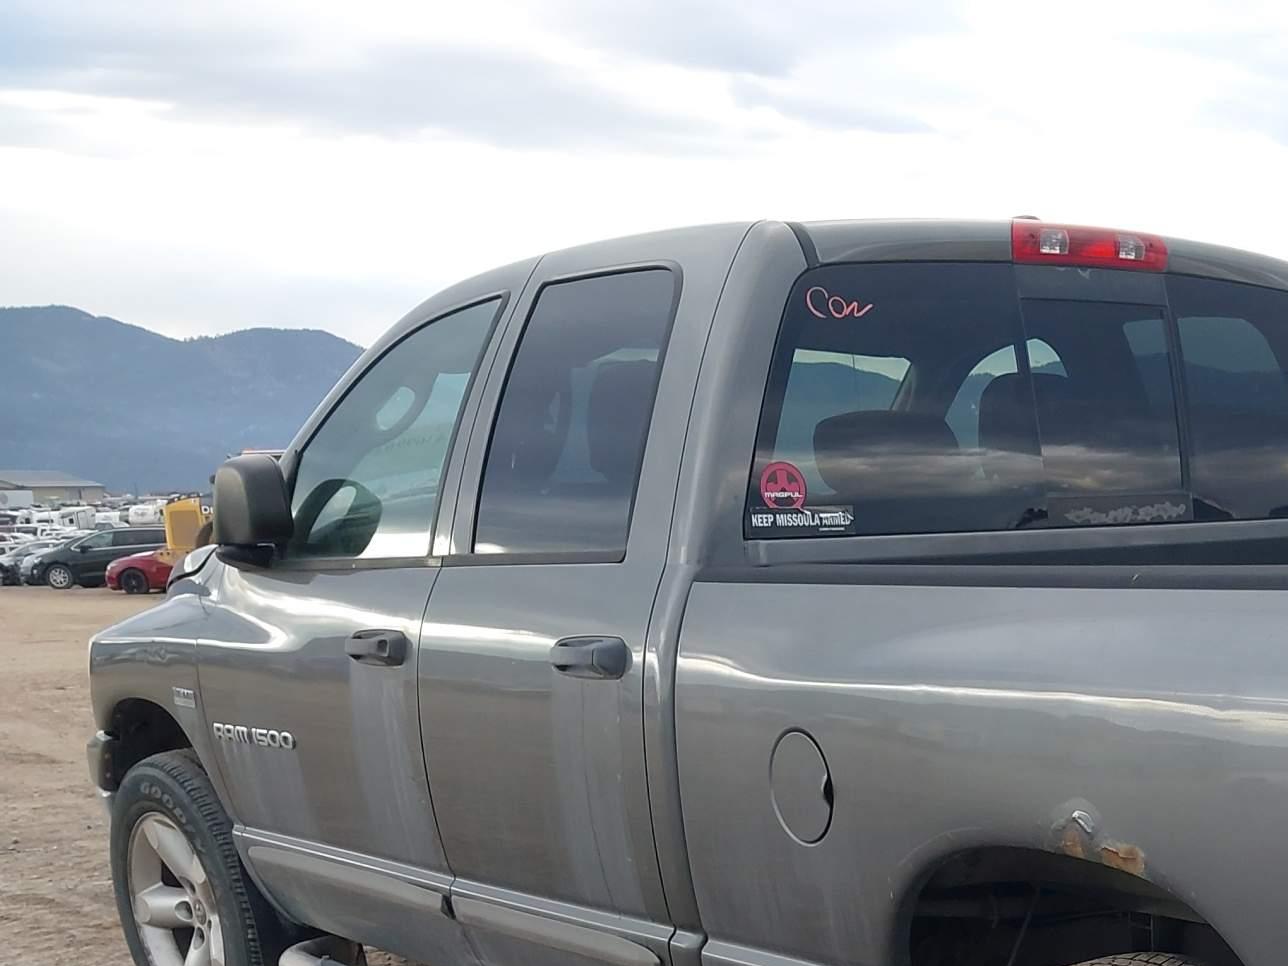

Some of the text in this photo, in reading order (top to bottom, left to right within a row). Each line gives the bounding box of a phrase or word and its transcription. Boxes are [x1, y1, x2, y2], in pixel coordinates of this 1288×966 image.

[751, 513, 774, 527] KEEP
[776, 513, 820, 527] MISSOULA
[213, 722, 294, 749] RAM 1500
